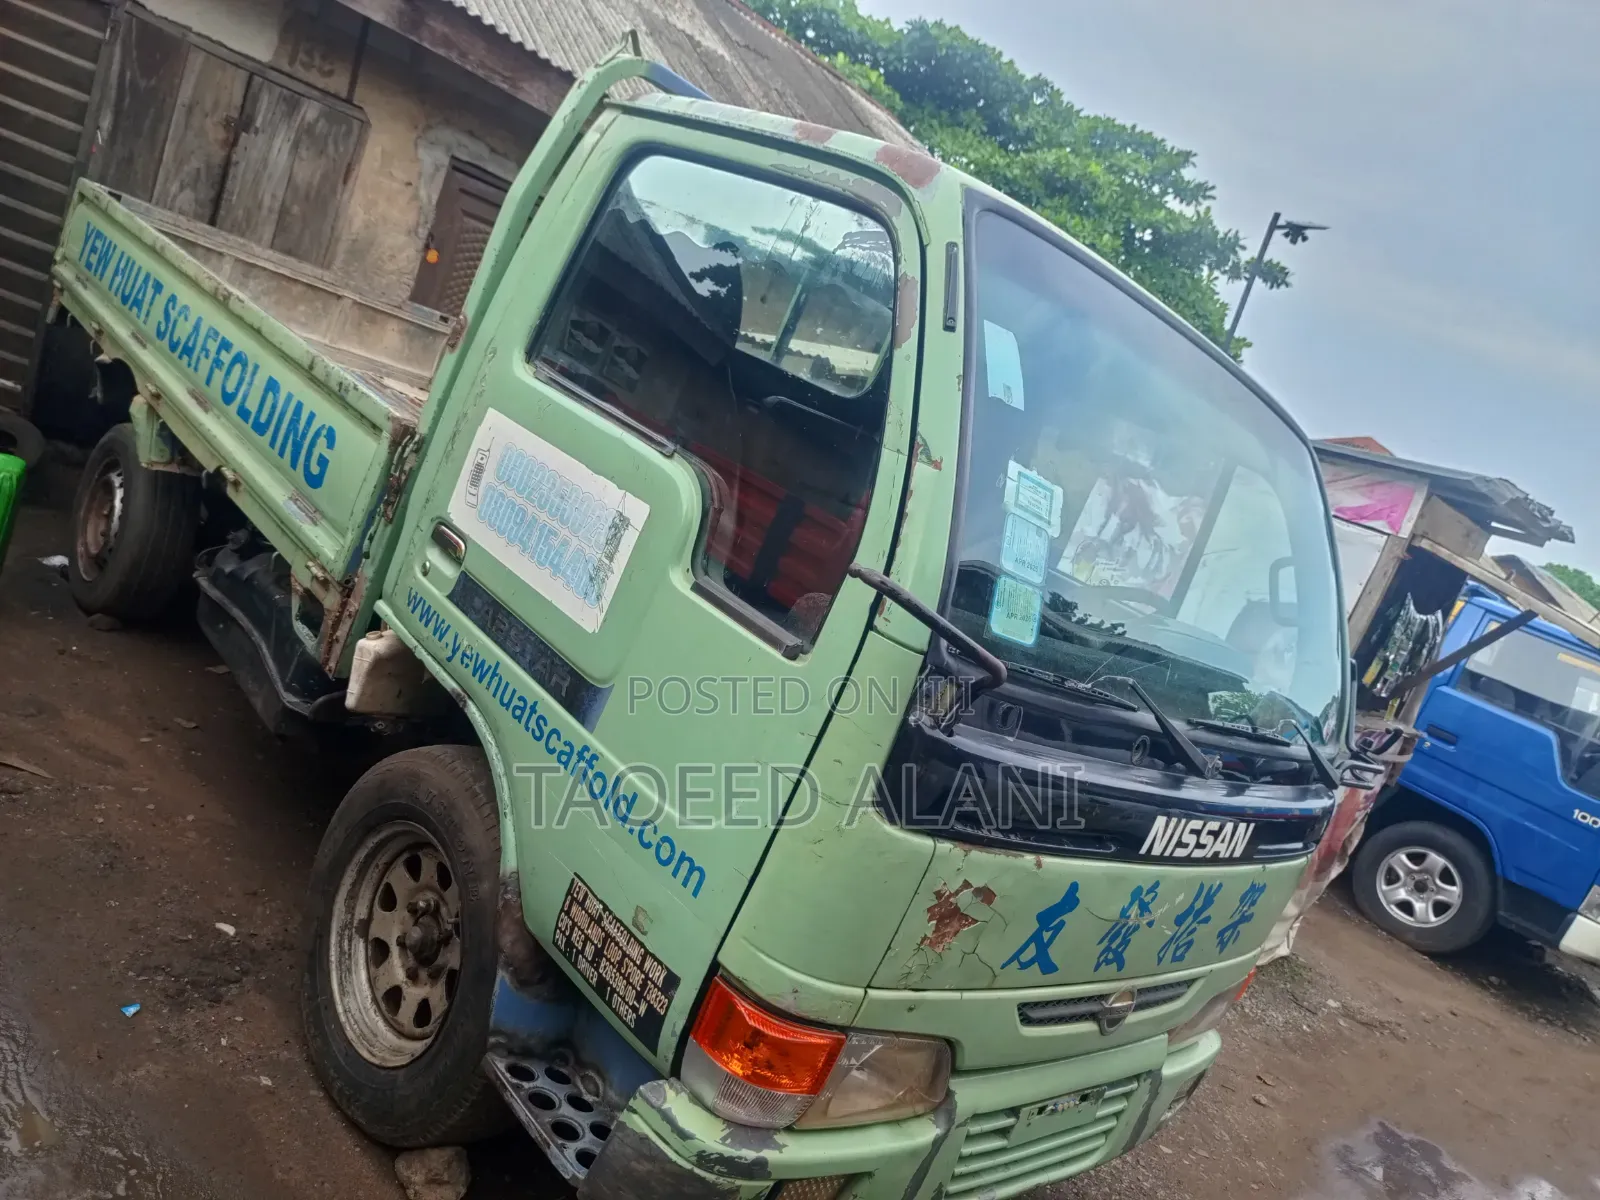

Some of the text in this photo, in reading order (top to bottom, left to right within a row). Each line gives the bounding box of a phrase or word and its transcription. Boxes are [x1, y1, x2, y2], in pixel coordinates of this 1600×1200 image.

[78, 220, 337, 490] YEW HUAT SCAFFOLDING
[405, 586, 707, 899] www.yewhuatscaffold.com
[1138, 815, 1255, 859] NISSAN
[554, 928, 567, 952] PAX
[576, 954, 598, 987] DRIVER
[611, 993, 637, 1029] OTHERS
[569, 900, 605, 949] WOODLANDS
[643, 980, 669, 1016] 738323
[570, 926, 585, 951] REG
[583, 940, 595, 961] NO
[601, 910, 645, 966] SCAFFOLDING
[642, 954, 667, 988] WORK
